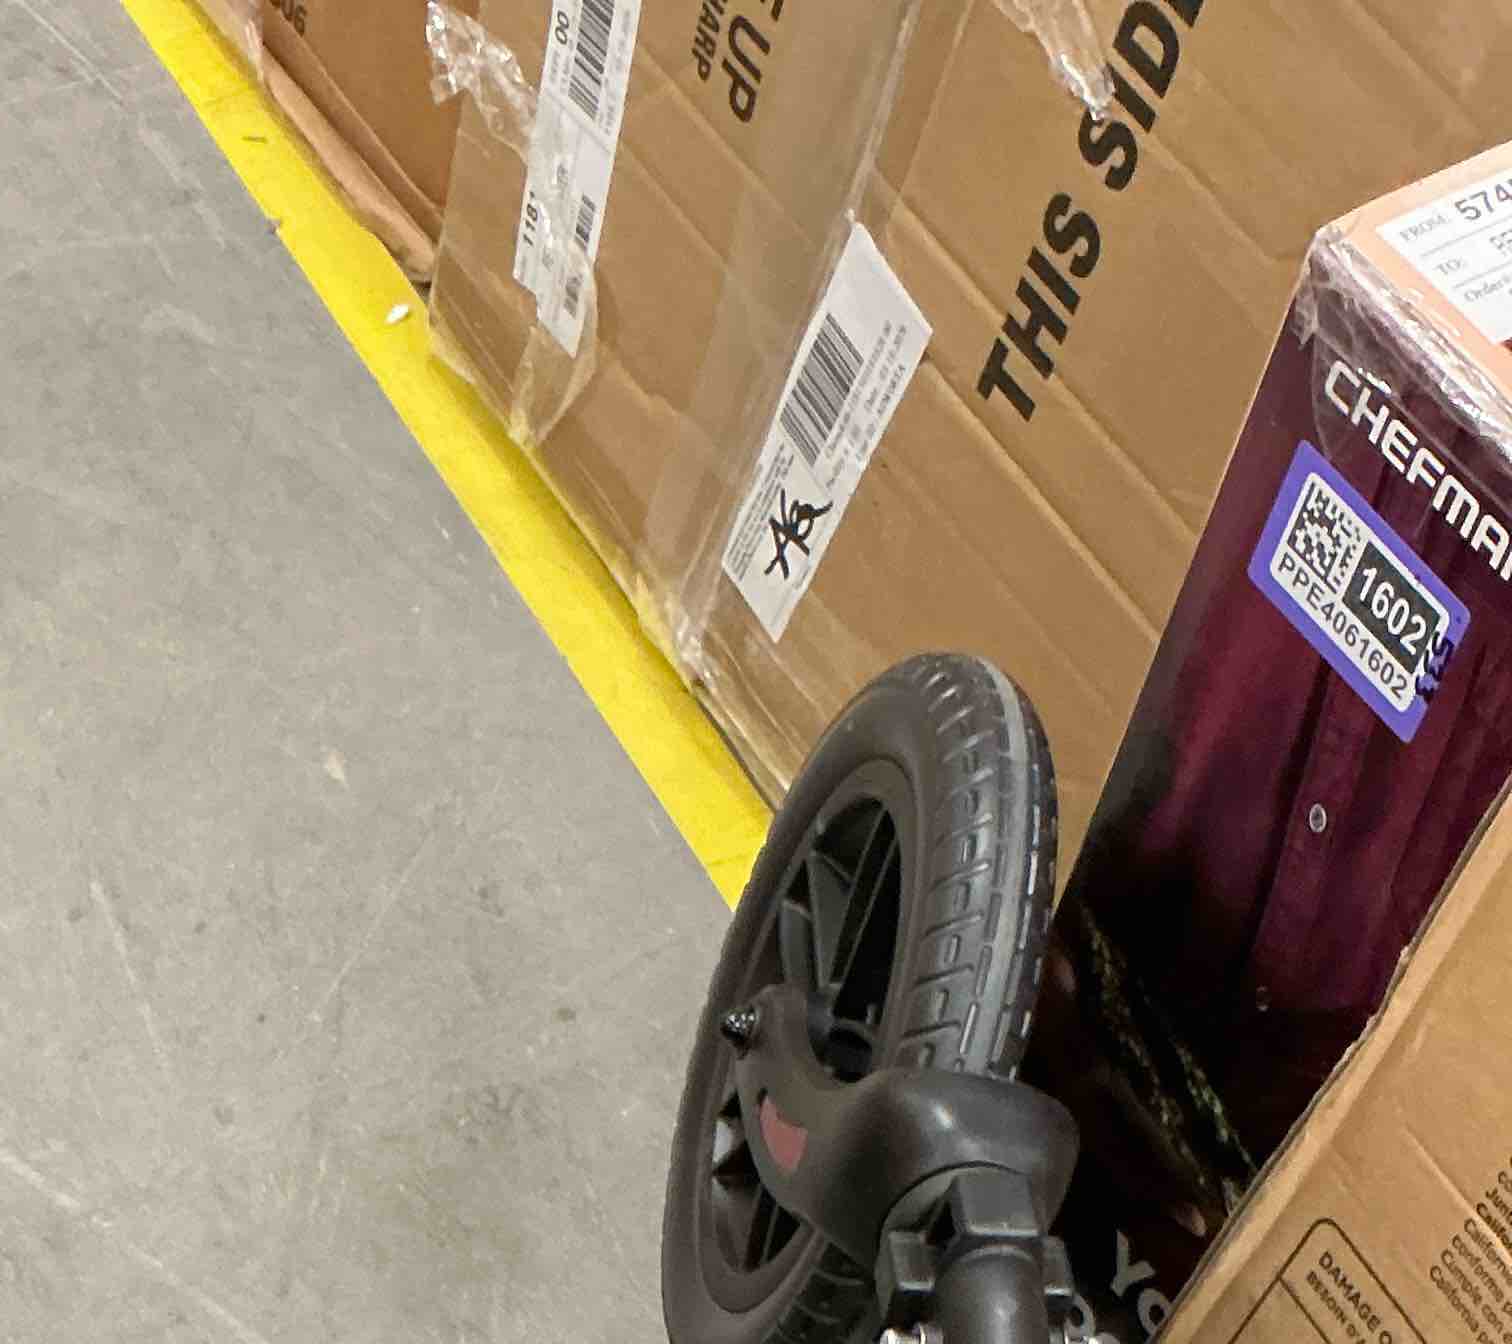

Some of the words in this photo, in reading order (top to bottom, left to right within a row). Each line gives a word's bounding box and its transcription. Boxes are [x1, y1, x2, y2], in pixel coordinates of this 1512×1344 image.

[722, 15, 771, 123] UP
[976, 192, 1101, 423] THIS
[1278, 551, 1409, 700] PPE4061602
[1358, 566, 1428, 657] 1602
[1319, 1251, 1381, 1333] DAMAGE
[1430, 1265, 1479, 1333] California
